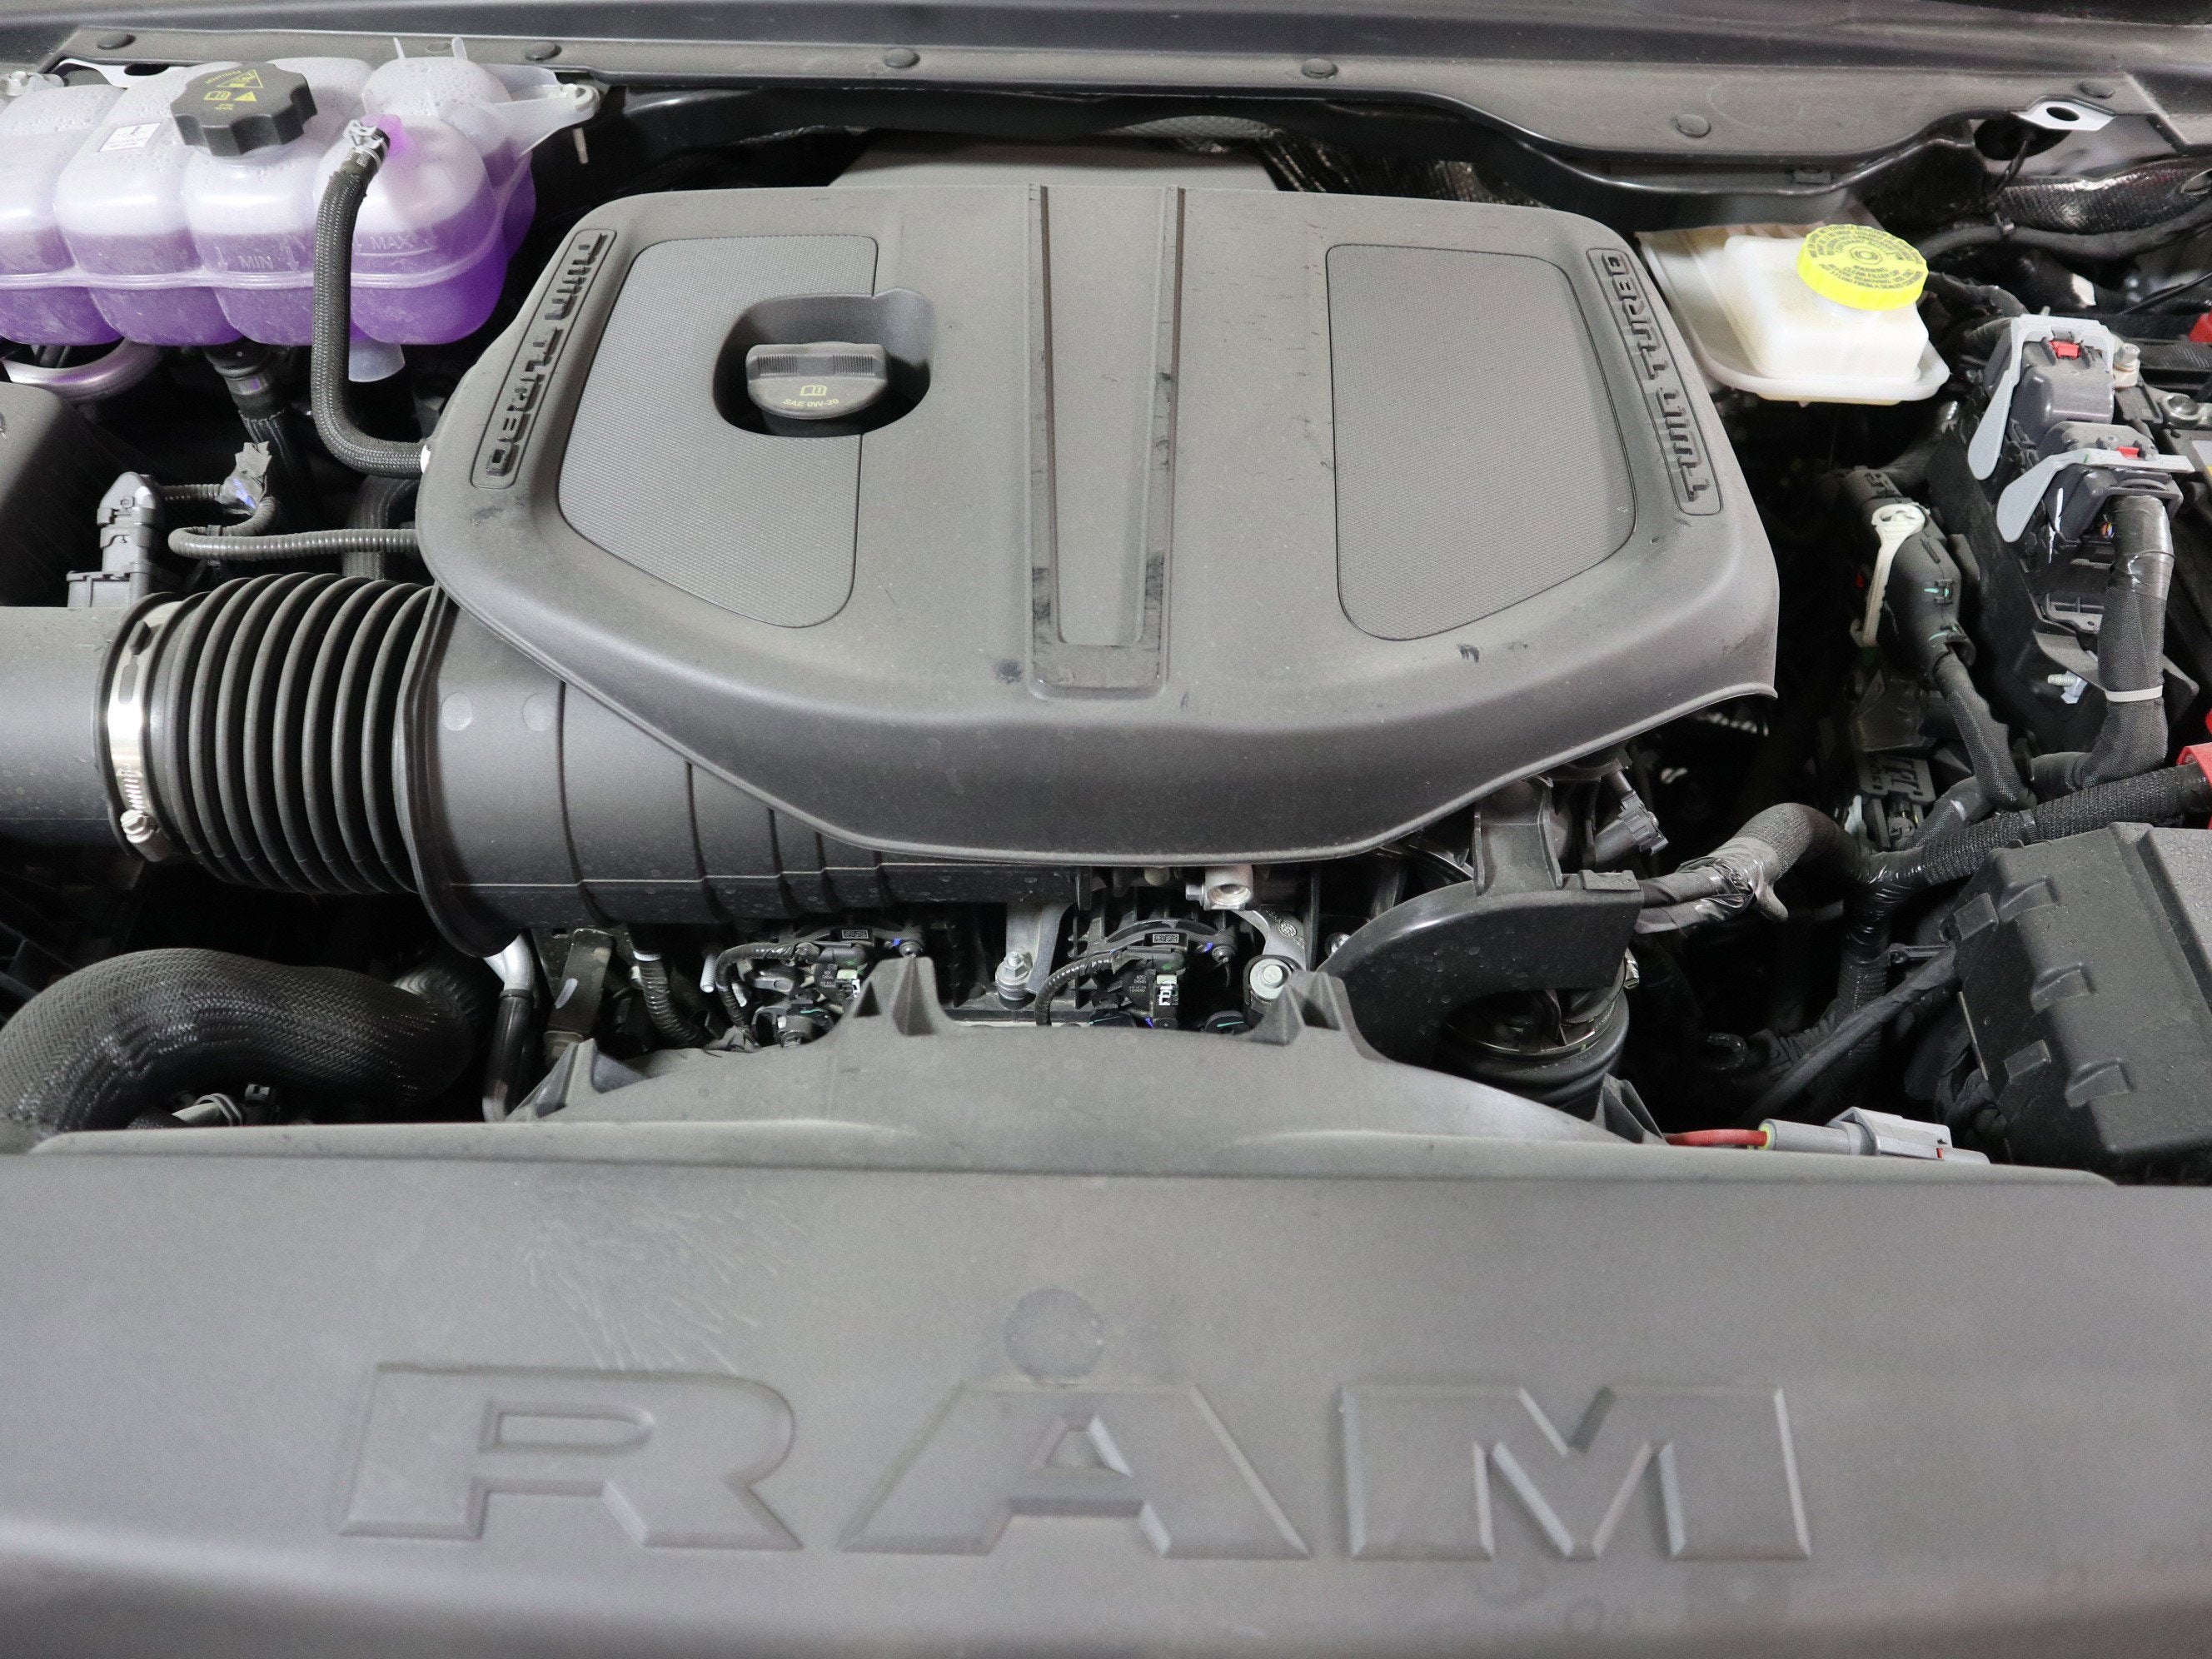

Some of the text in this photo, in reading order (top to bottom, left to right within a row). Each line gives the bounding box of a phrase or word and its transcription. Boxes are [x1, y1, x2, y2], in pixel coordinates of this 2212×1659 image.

[238, 255, 274, 270] MIN
[369, 235, 413, 251] MAX
[486, 232, 608, 476] TWIN TURBO
[782, 398, 839, 408] SAE 0W-20
[1601, 252, 1709, 502] TWIN TURBO
[340, 1361, 1813, 1560] RAM
